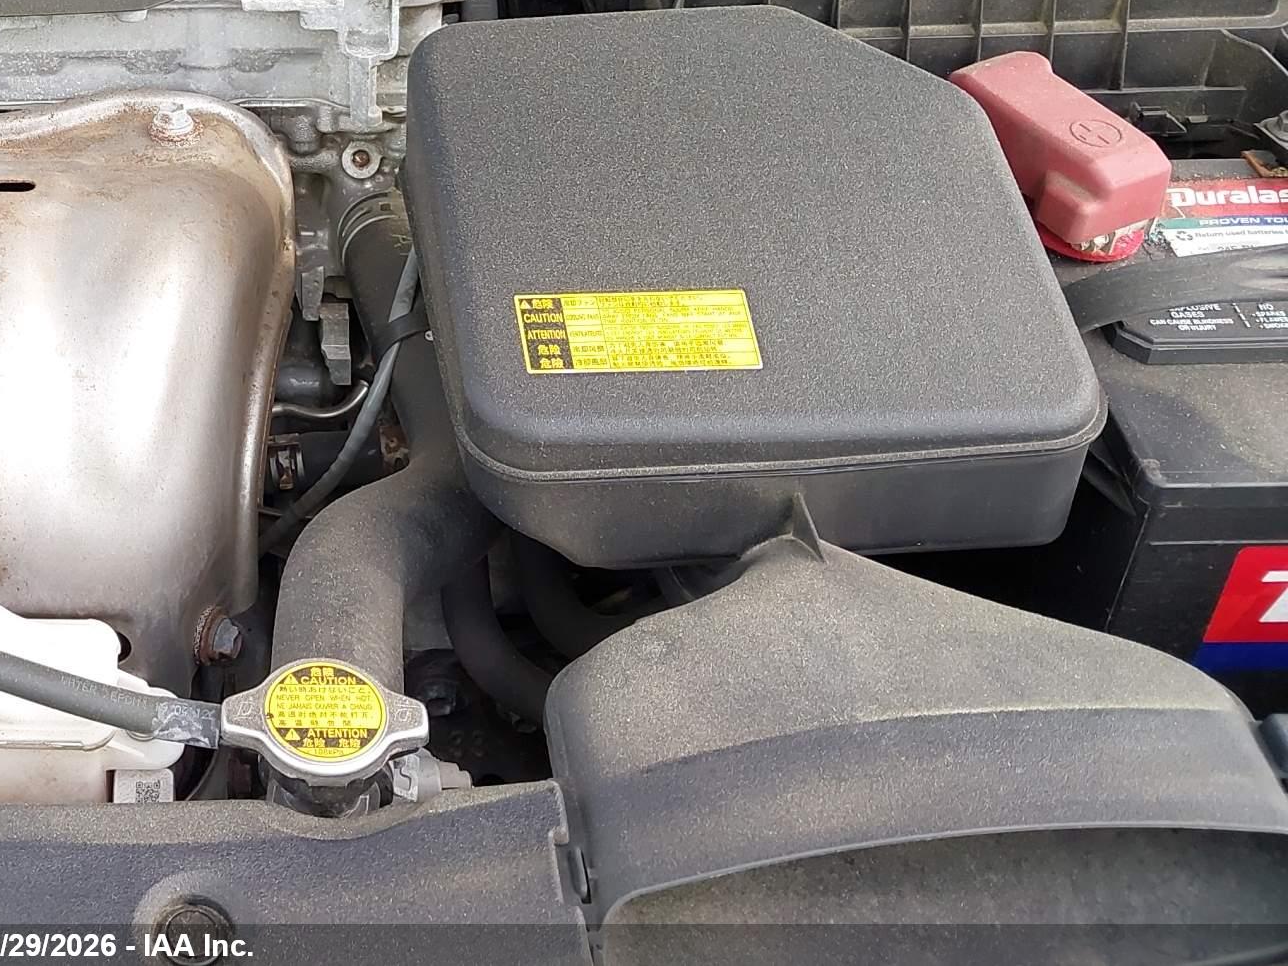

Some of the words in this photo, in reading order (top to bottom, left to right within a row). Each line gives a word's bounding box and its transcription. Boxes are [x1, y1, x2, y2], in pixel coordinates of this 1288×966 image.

[1199, 218, 1261, 226] PROVEN
[1194, 230, 1224, 238] Return
[523, 313, 564, 324] CAUTION
[527, 329, 565, 340] ATTENTION
[300, 676, 357, 685] CAUTION
[276, 694, 300, 702] NEVER
[305, 694, 325, 702] OPEN
[330, 694, 351, 702] WHEN
[307, 728, 368, 738] ATTENTION
